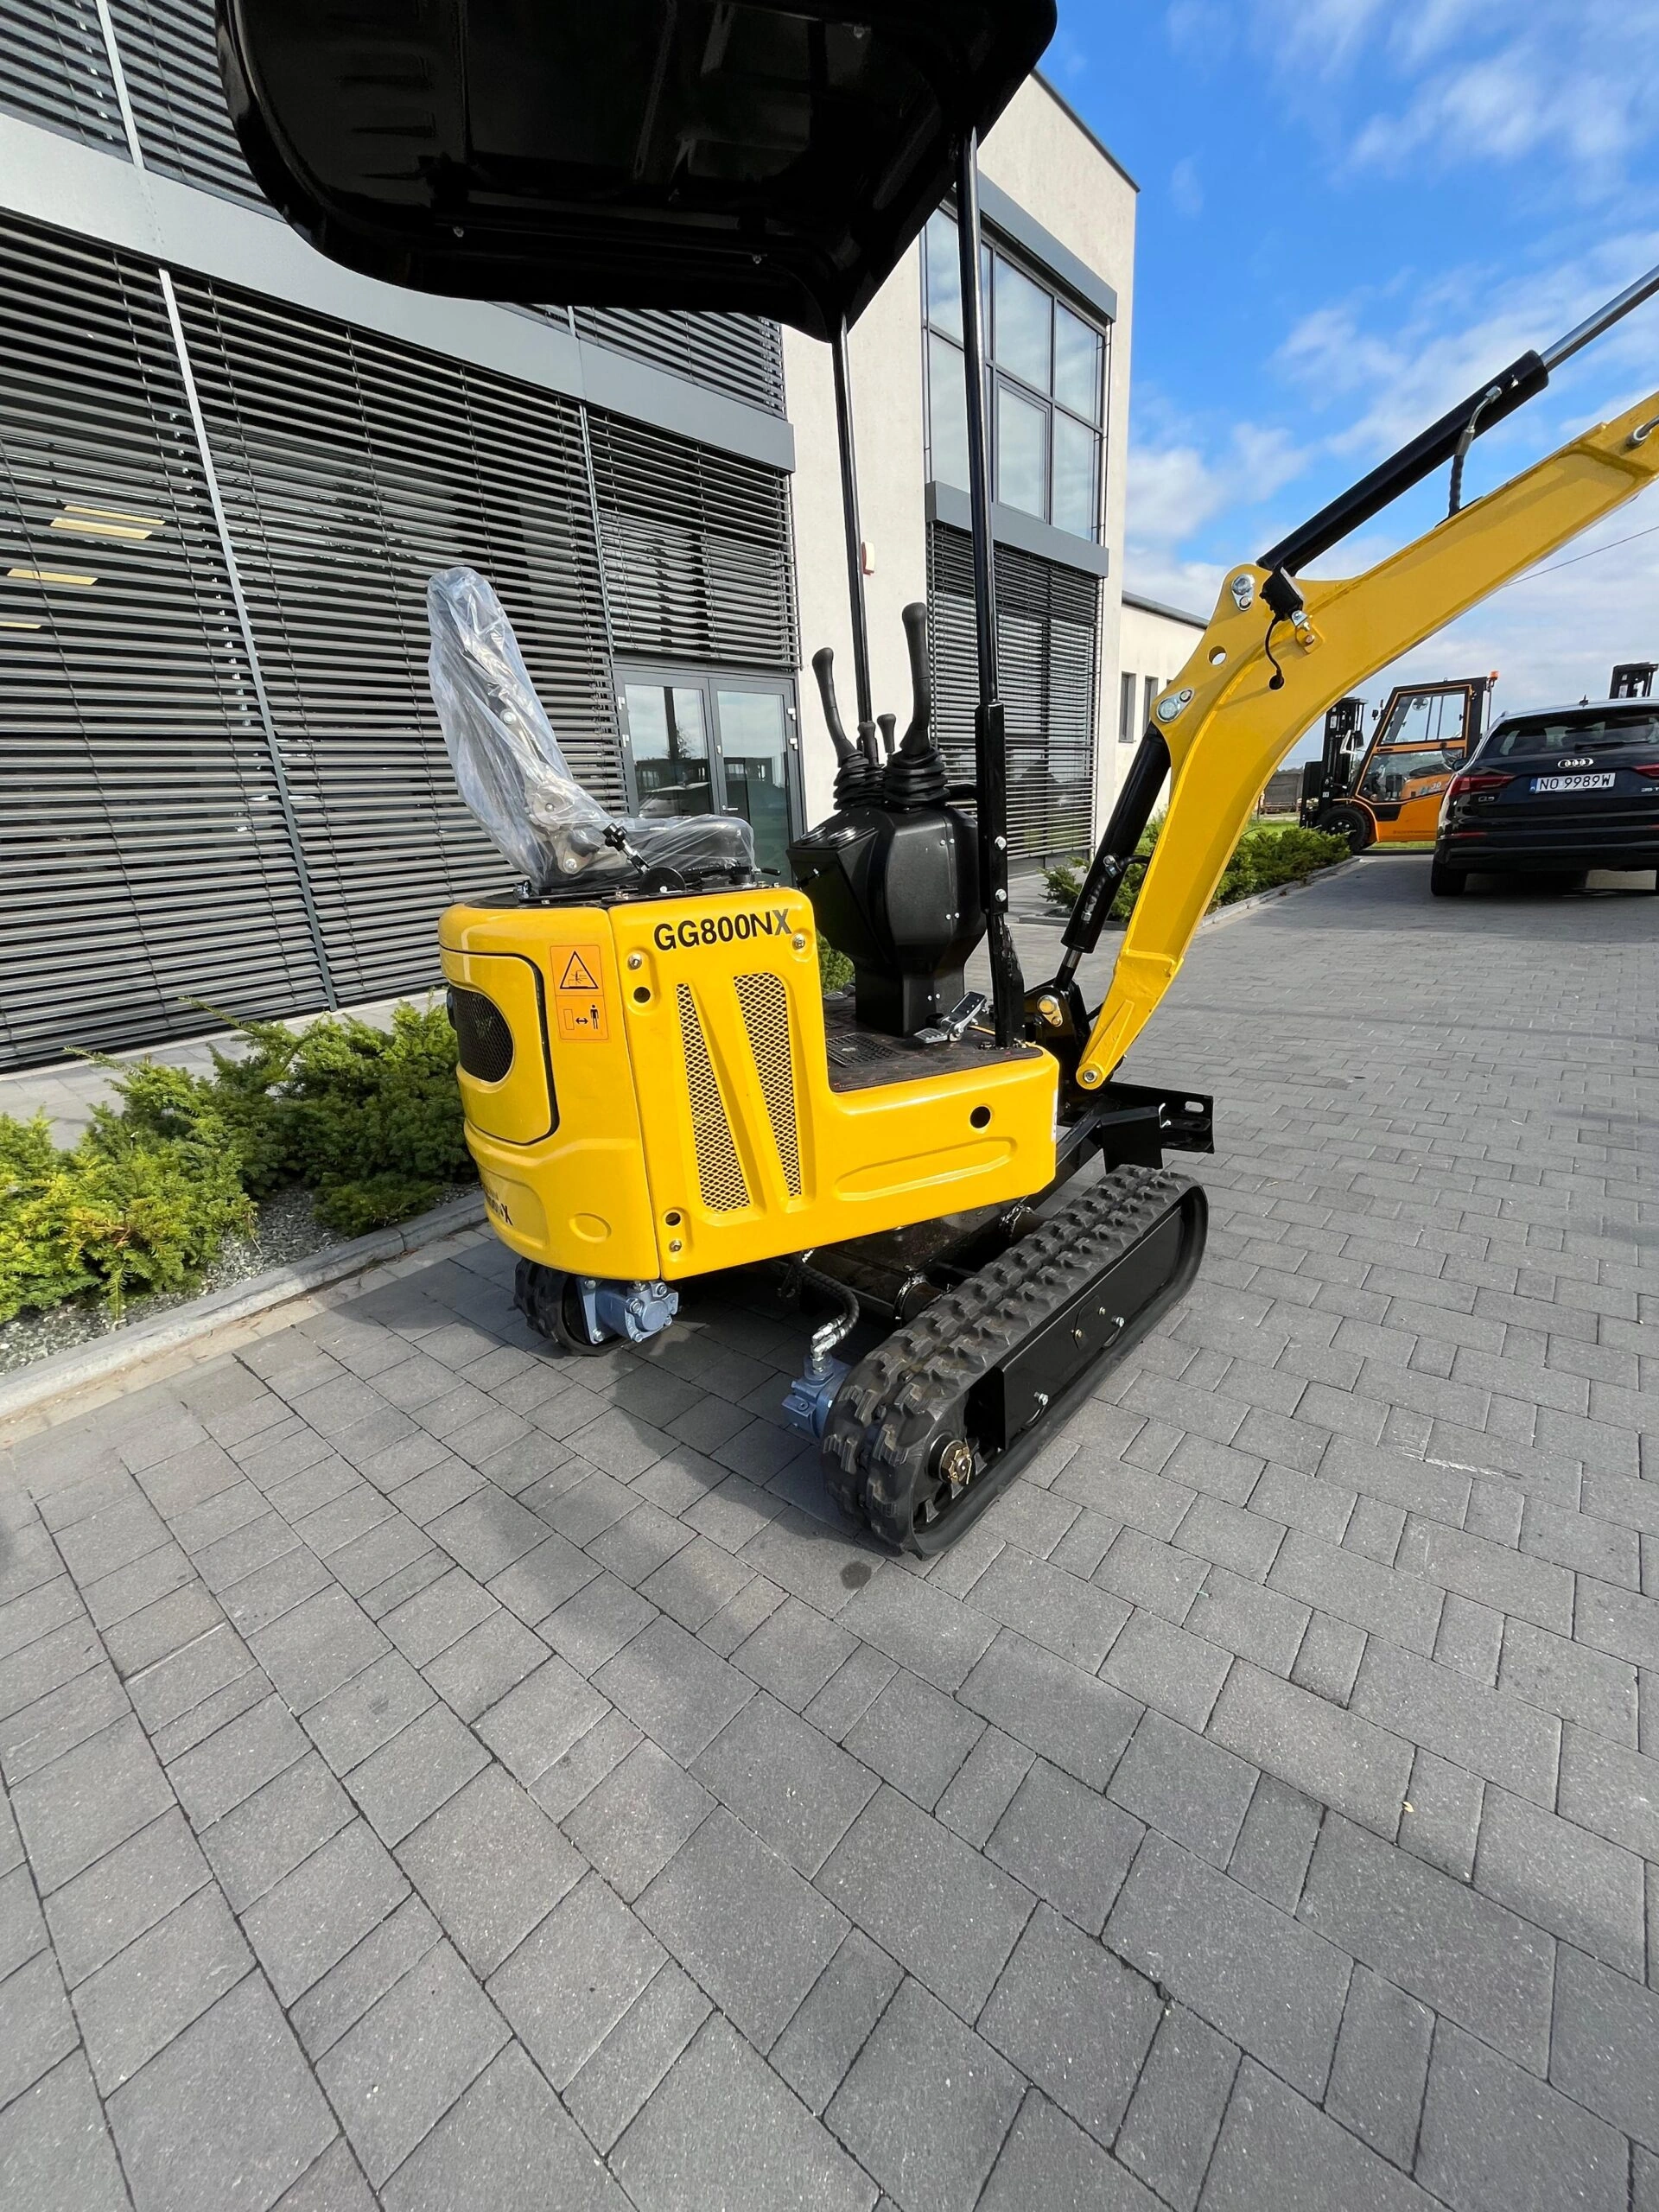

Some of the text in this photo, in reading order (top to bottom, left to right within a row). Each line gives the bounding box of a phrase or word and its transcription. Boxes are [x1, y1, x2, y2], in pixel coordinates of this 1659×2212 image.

[1539, 774, 1611, 791] NO 9989W
[654, 909, 791, 950] GG800NX
